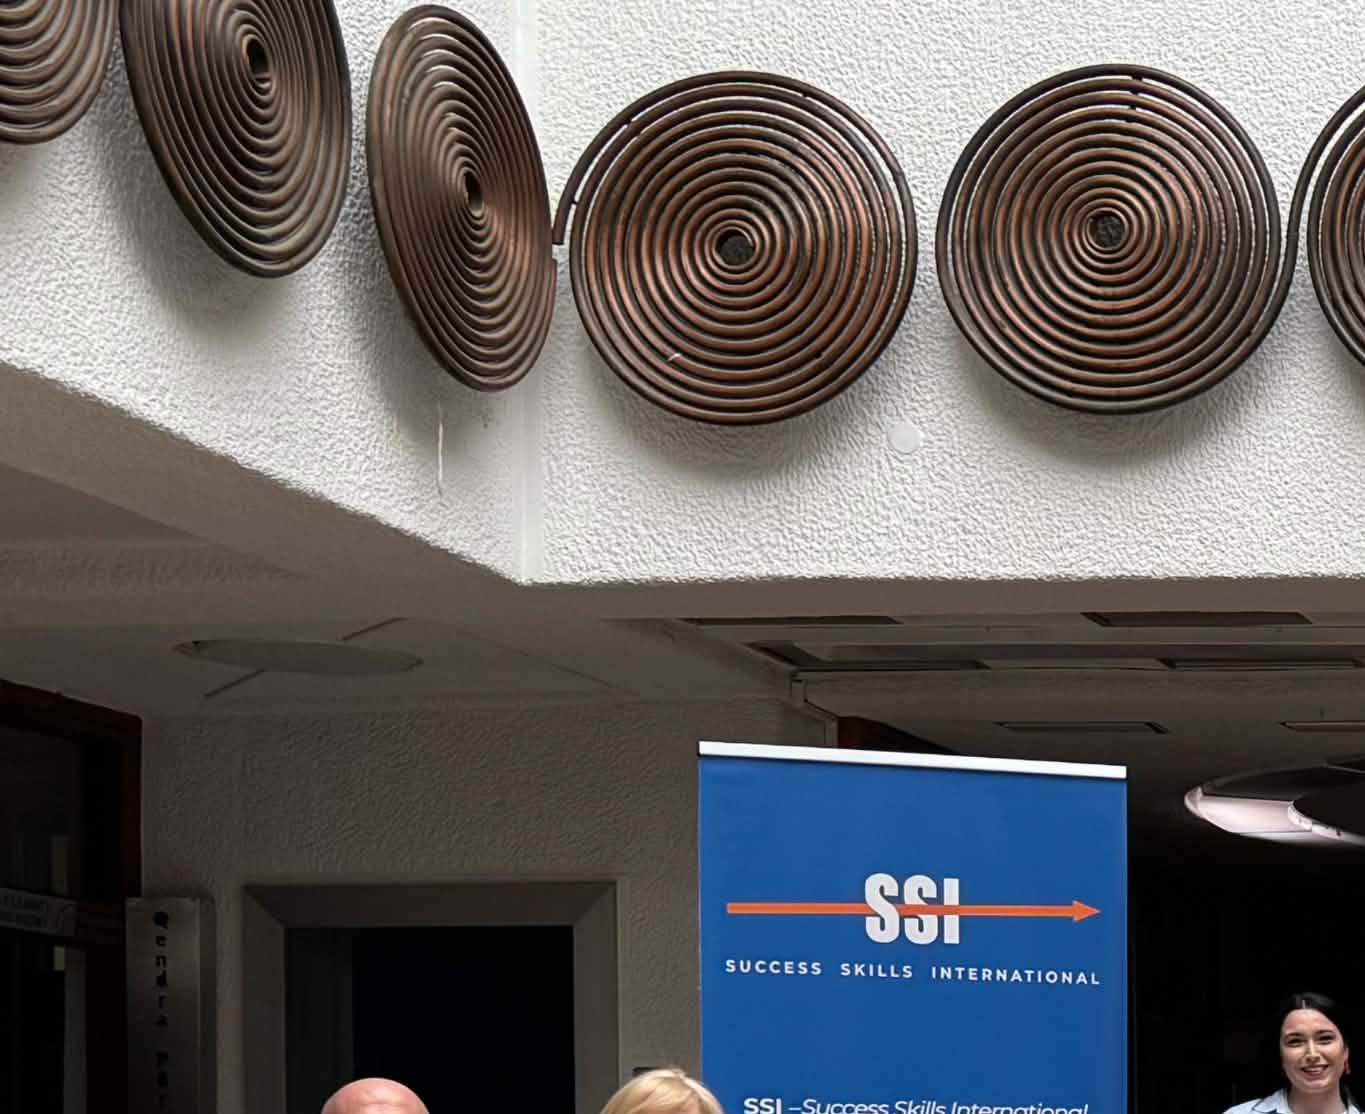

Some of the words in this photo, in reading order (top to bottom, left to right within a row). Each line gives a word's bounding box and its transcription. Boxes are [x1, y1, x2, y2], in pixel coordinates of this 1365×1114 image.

[865, 873, 960, 944] SSI
[725, 959, 823, 976] SUCCESS
[840, 962, 914, 979] SKILLS
[931, 965, 1101, 986] INTERNATIONAL
